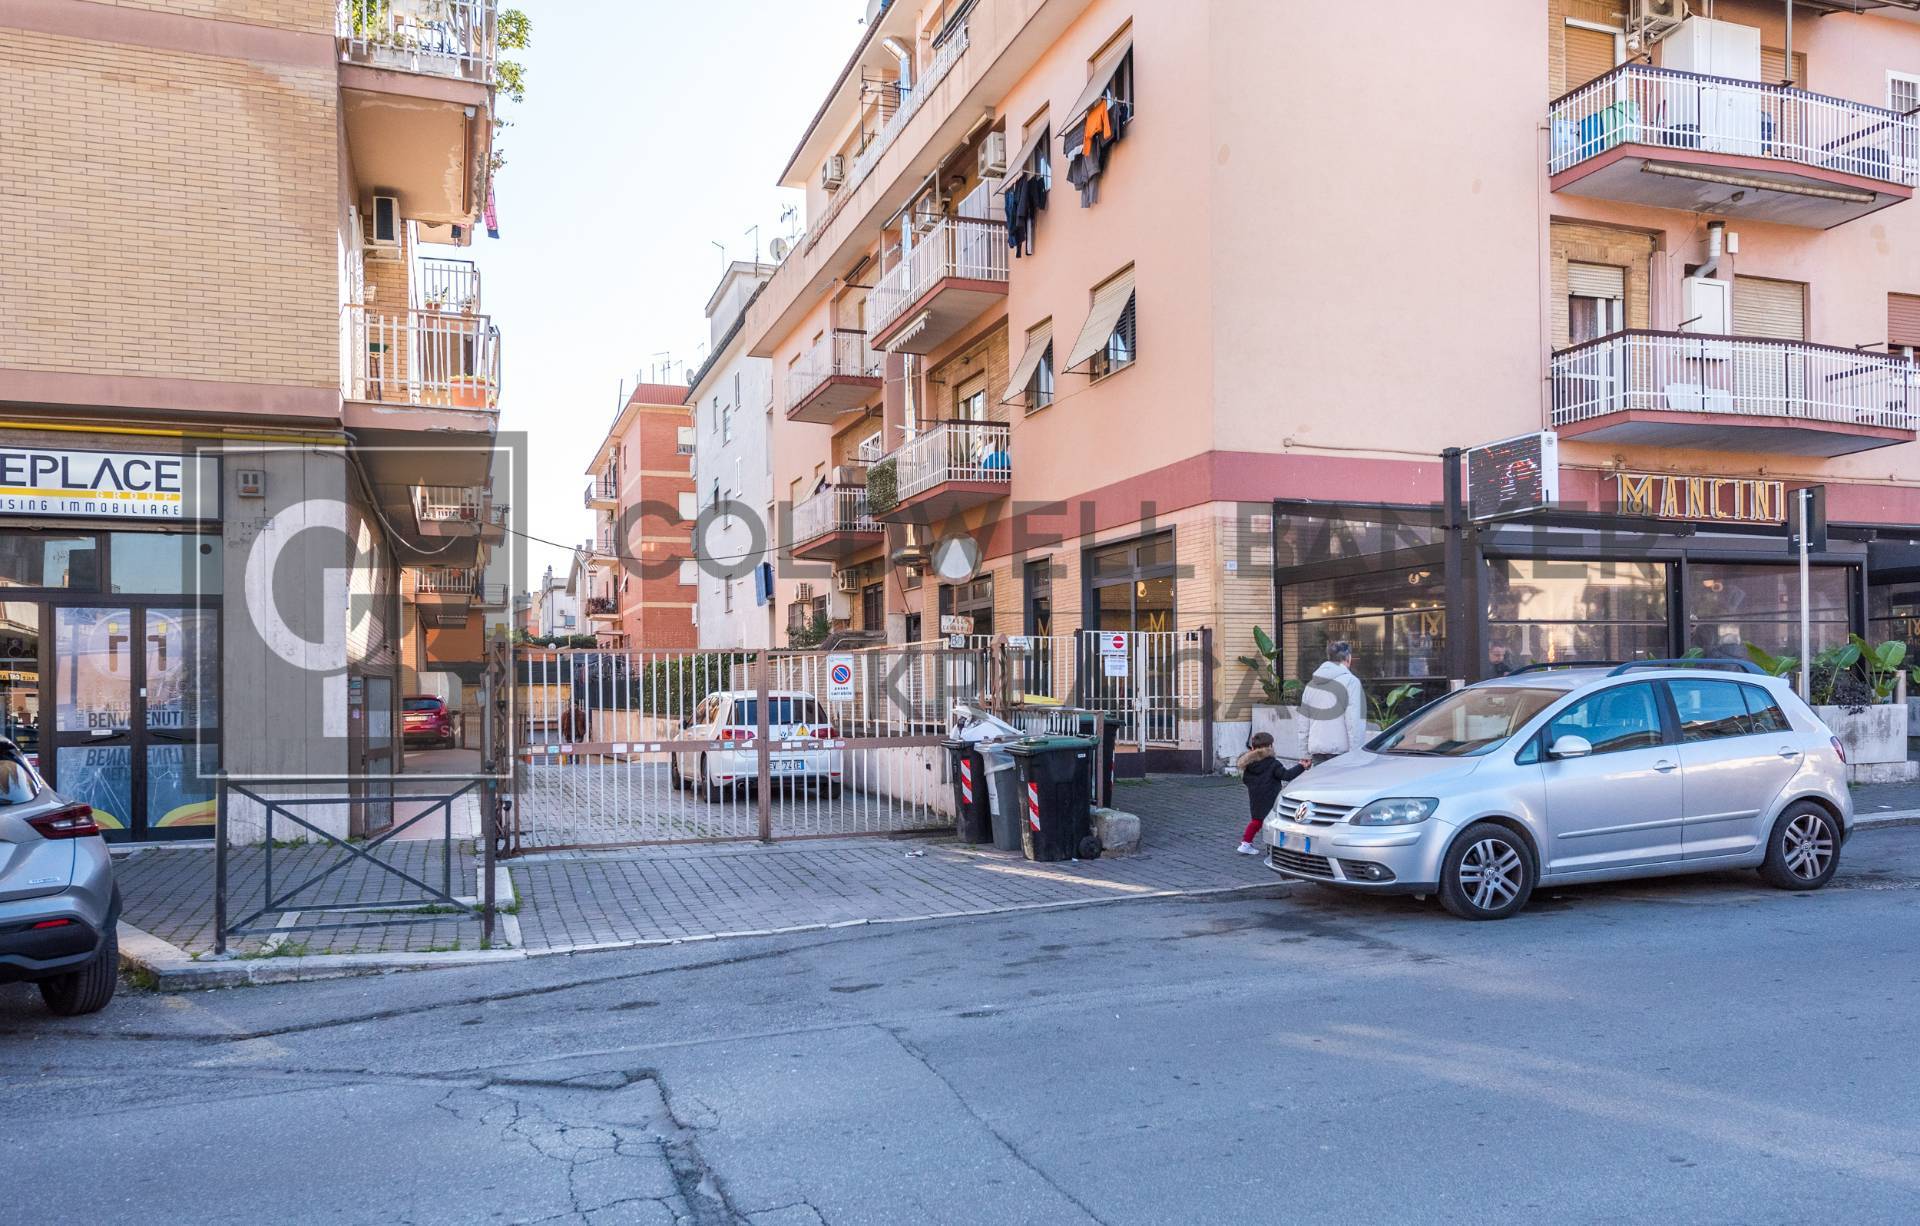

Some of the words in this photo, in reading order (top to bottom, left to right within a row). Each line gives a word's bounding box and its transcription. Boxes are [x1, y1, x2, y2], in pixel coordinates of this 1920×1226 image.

[95, 490, 173, 501] GROUP
[1617, 474, 1785, 521] MANCINI
[61, 500, 179, 515] IMMOBILIARE
